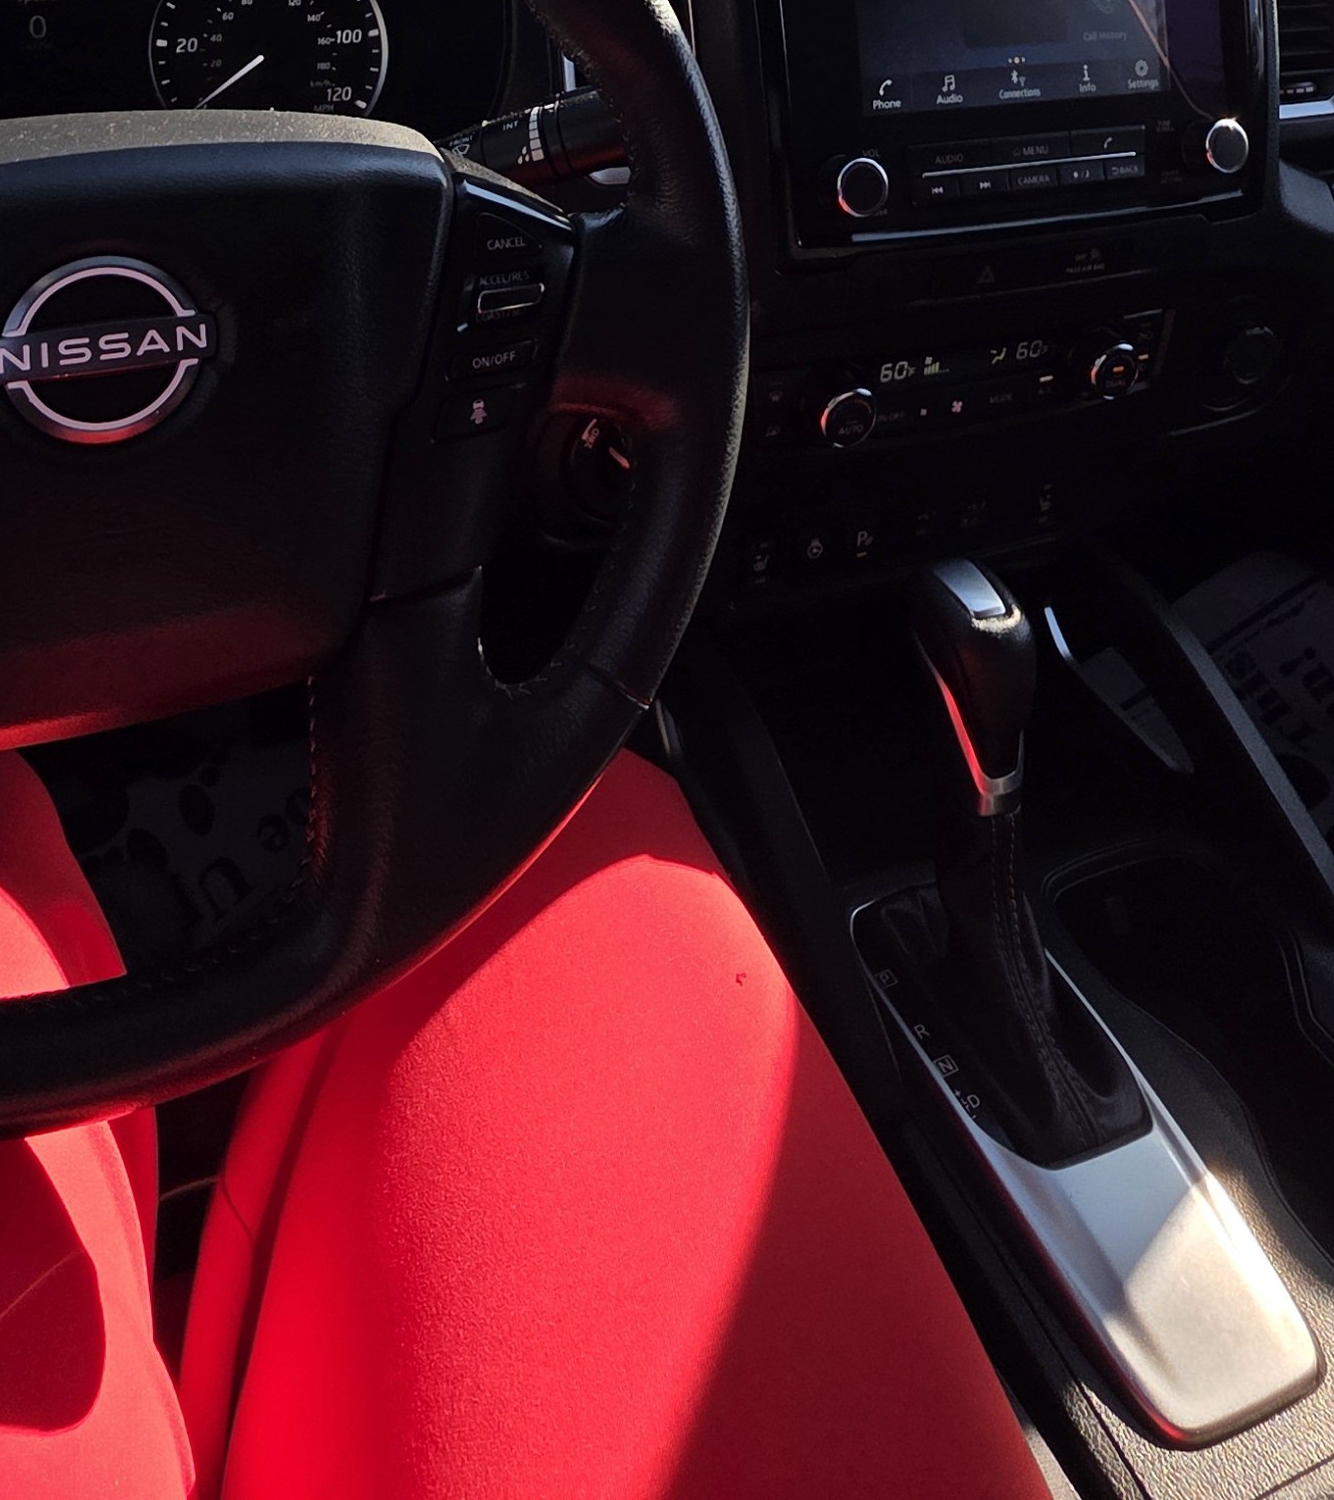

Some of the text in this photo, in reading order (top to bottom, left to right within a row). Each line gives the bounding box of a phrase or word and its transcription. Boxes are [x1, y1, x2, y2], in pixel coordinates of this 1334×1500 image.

[28, 14, 48, 40] 0
[336, 28, 363, 45] 100
[175, 37, 199, 54] 20
[1079, 82, 1097, 93] Info
[1127, 77, 1159, 90] Settings
[326, 86, 353, 102] 120
[936, 94, 964, 105] Audio
[999, 87, 1041, 100] Connections
[872, 99, 902, 110] Phone
[502, 120, 519, 131] INT
[1021, 145, 1049, 158] MENU
[934, 153, 964, 165] AUDIO
[1017, 174, 1051, 186] CAMERA
[486, 236, 527, 251] CANCEL
[472, 351, 516, 370] ON/OFF
[837, 422, 865, 437] AUTO
[1224, 648, 1317, 750] This
